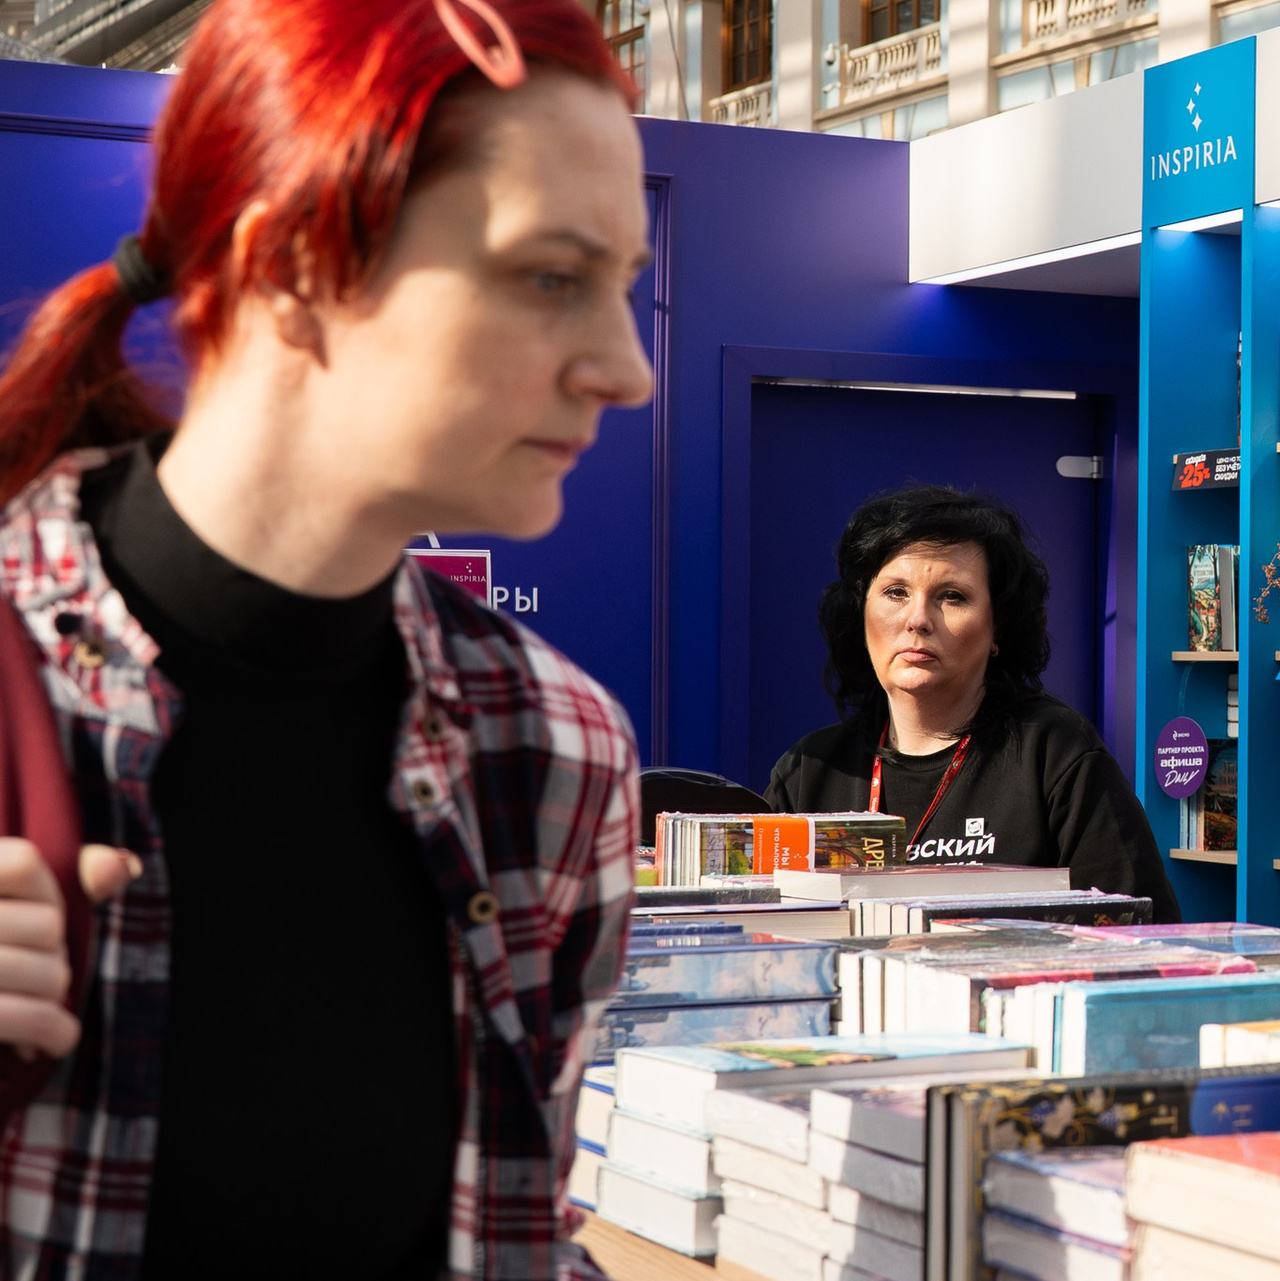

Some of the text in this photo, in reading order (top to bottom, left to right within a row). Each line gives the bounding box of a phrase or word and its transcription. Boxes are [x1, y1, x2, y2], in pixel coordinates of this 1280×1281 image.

[1151, 136, 1237, 180] INSPIRIA
[1179, 462, 1210, 488] -25%
[493, 586, 538, 612] РЫ
[1160, 756, 1202, 769] афиша
[782, 847, 790, 865] МЫ
[906, 833, 996, 861] ВСКИЙ
